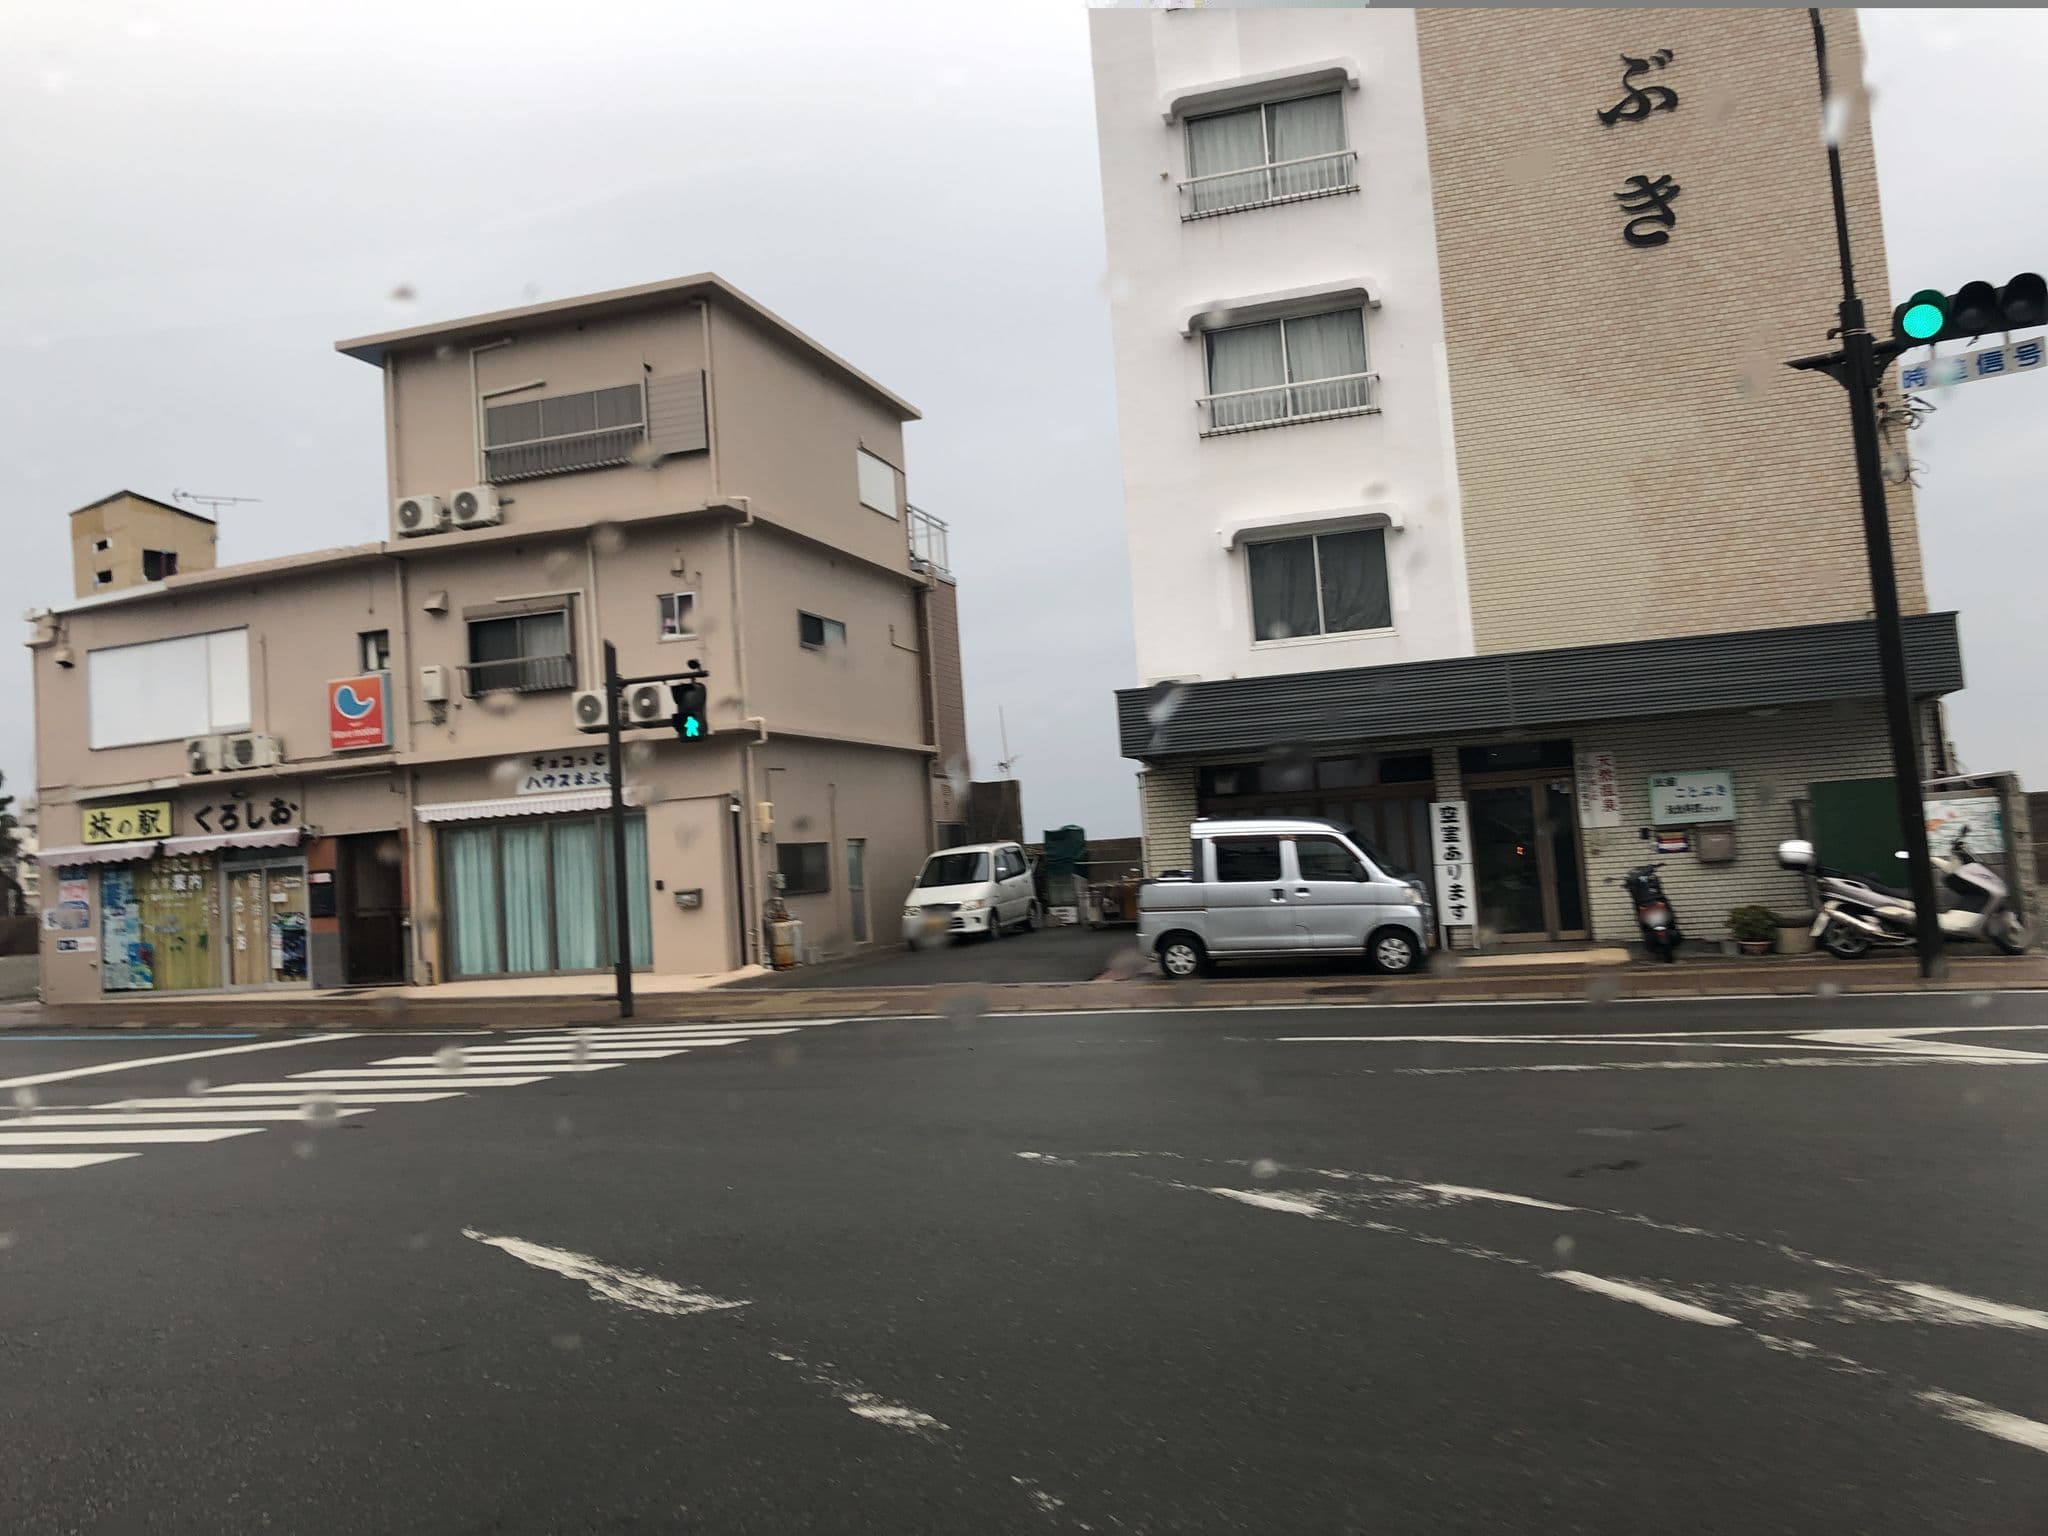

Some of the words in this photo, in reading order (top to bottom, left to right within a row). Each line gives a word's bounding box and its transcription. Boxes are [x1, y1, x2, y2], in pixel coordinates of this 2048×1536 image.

[195, 797, 299, 833] くろしお
[1439, 806, 1469, 921] 空室あります
